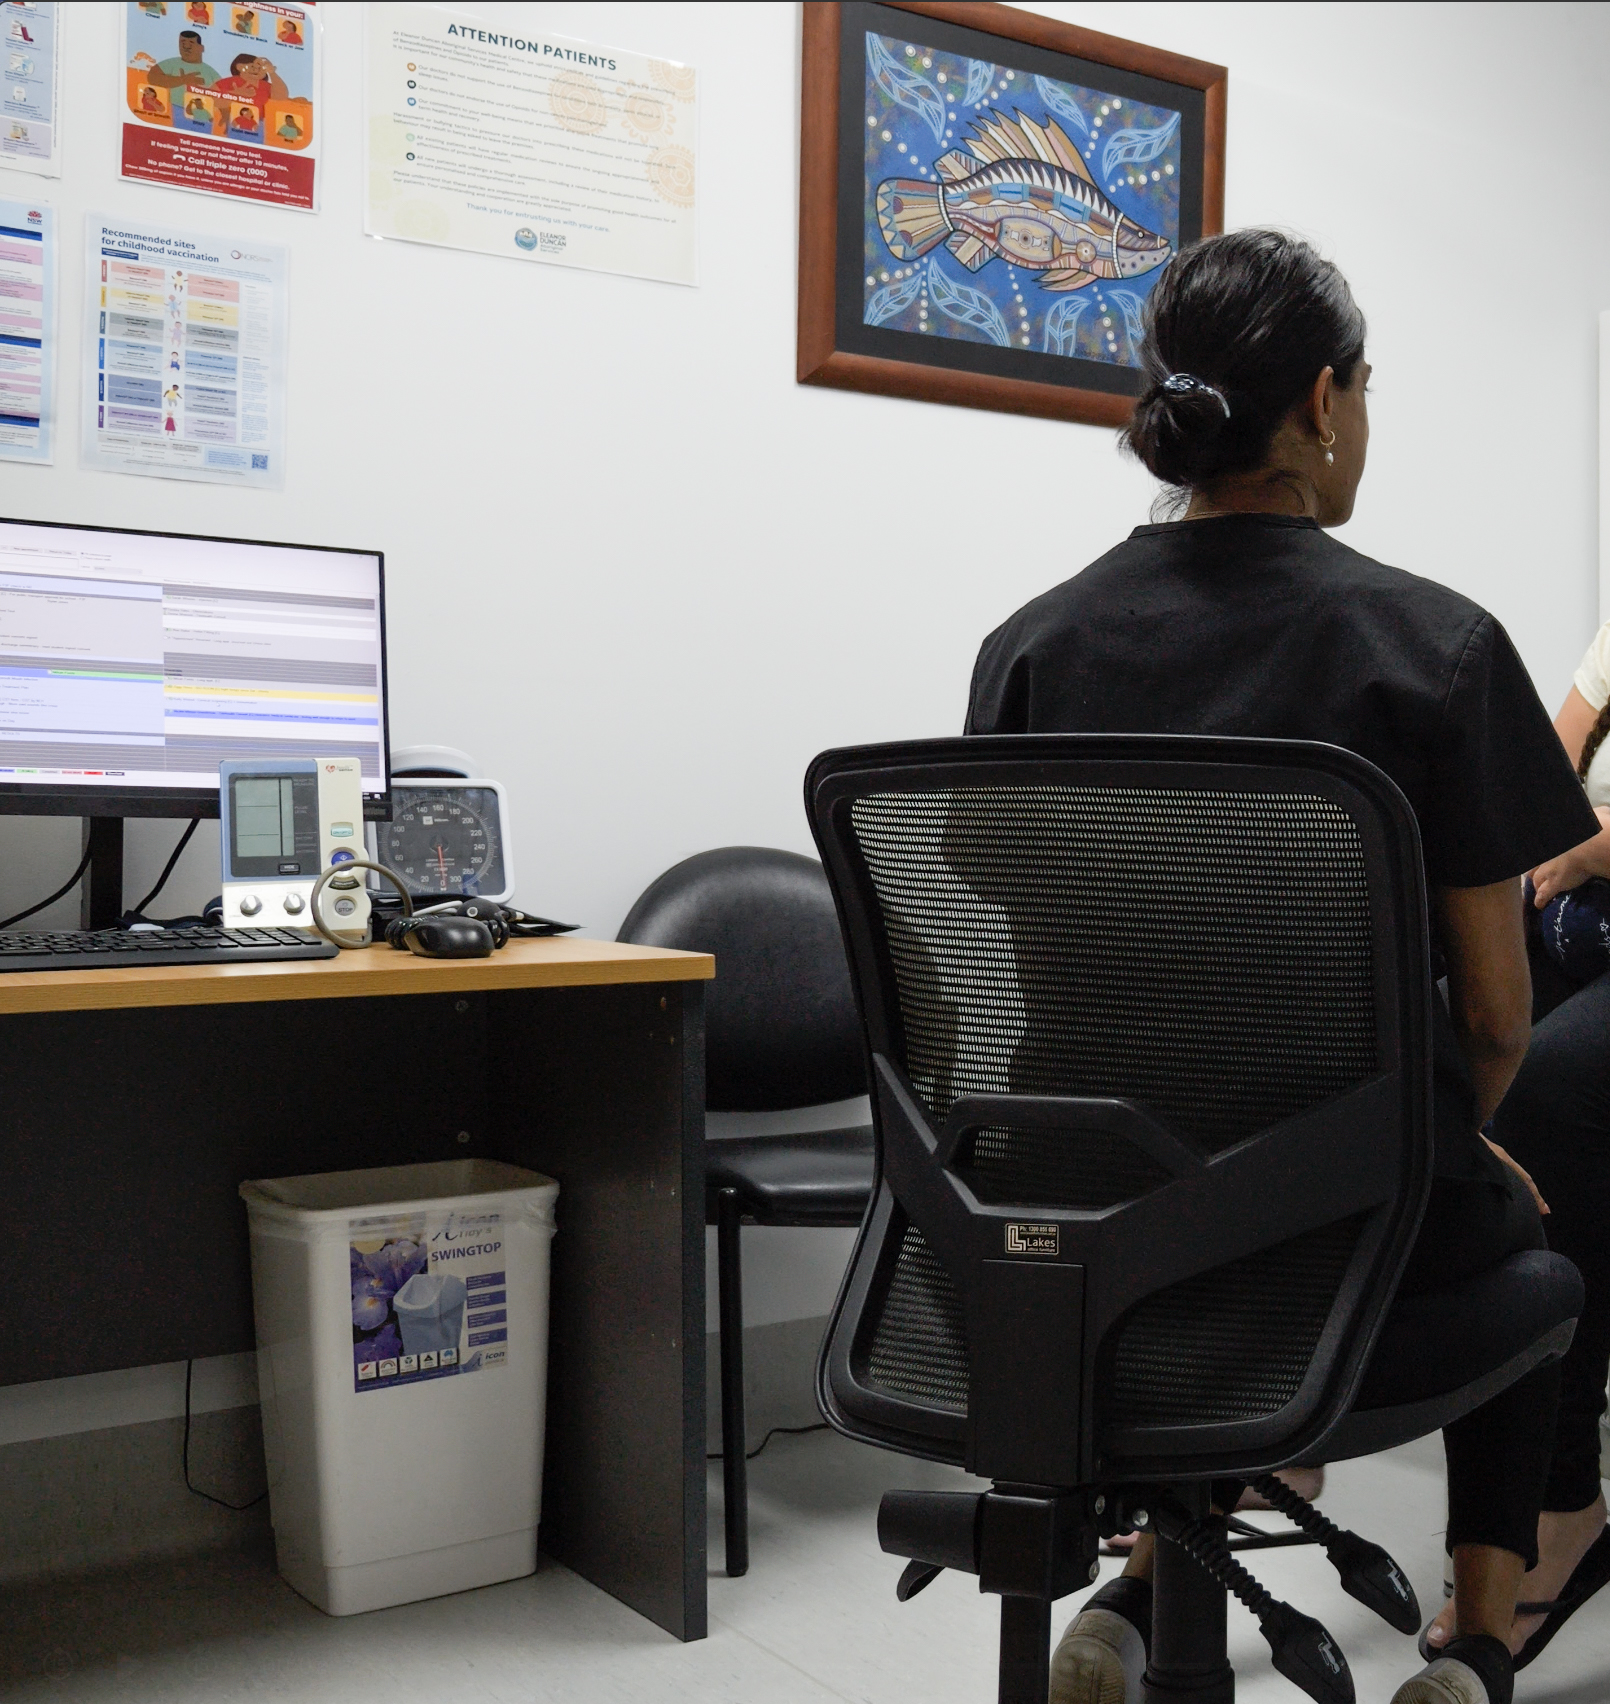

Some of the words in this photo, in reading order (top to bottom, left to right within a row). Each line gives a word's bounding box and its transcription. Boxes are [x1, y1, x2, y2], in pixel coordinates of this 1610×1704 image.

[286, 10, 303, 19] your:
[447, 24, 538, 52] ATTENTION
[543, 44, 616, 70] PATIENTS
[190, 86, 204, 96] You
[204, 89, 221, 98] may
[238, 95, 254, 104] feel:
[156, 141, 179, 151] feeling
[191, 141, 220, 151] someone
[157, 161, 182, 169] phone?
[238, 175, 263, 184] hospital
[187, 156, 205, 165] Call
[205, 159, 227, 169] triple
[228, 164, 245, 172] zero
[246, 167, 267, 177] (000)
[466, 202, 487, 211] Thank
[514, 212, 551, 223] entrusting
[101, 227, 171, 243] Recommended
[173, 239, 195, 249] sites
[539, 232, 565, 240] ELEANOR
[539, 238, 566, 246] DUNCAN
[101, 237, 115, 246] for
[117, 240, 164, 253] childhood
[166, 249, 219, 262] vaccination
[432, 1241, 501, 1262] SWINGTOP
[1027, 1238, 1055, 1247] Lakes
[485, 1351, 504, 1360] icon
